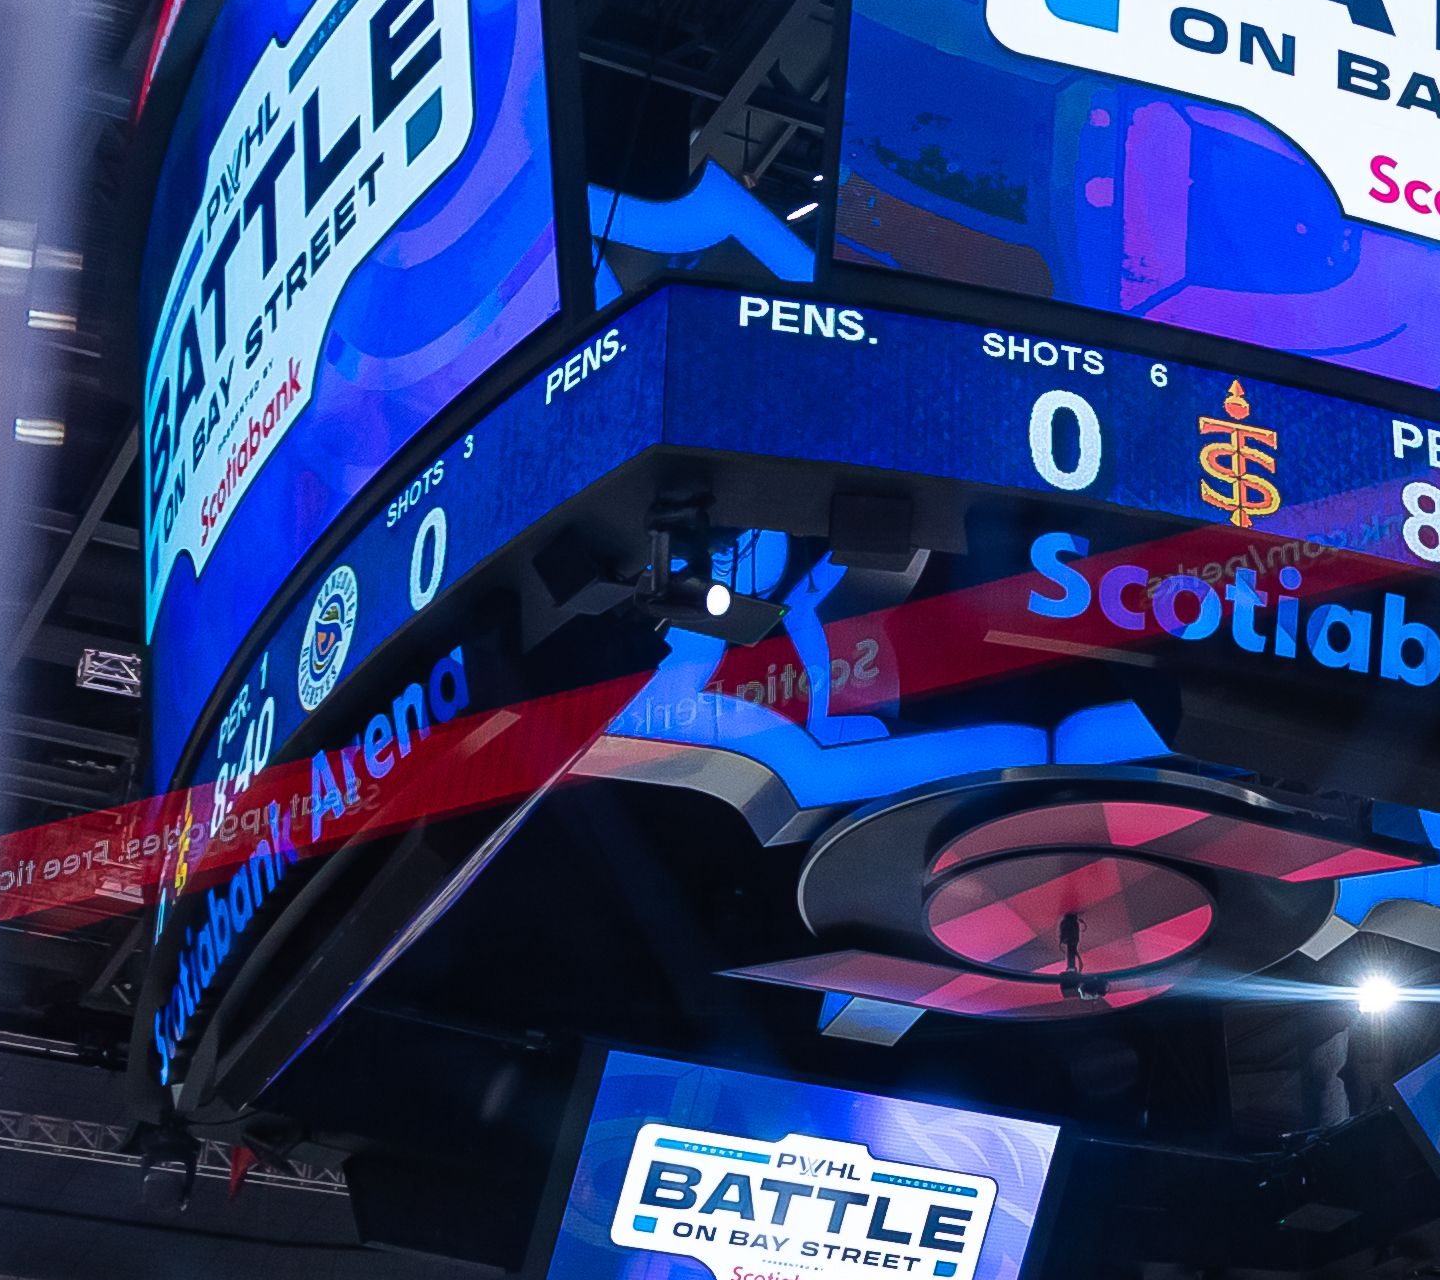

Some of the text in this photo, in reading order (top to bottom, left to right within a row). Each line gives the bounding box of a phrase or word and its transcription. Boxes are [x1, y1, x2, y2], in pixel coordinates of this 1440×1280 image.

[1169, 6, 1296, 76] ON
[206, 92, 281, 242] PWHL
[165, 153, 385, 544] ON BAY STREET
[545, 328, 628, 406] PENS.
[739, 296, 1169, 388] PENS. SHOTS 6
[200, 356, 302, 548] Scotiabank
[386, 434, 474, 528] SHOTS 3
[1029, 389, 1102, 491] 0
[410, 506, 447, 612] 0
[216, 651, 270, 758] PER. 1
[210, 696, 277, 839] 8:40
[154, 645, 471, 1082] Scotiabank Arena
[639, 1160, 974, 1254] BATTLE
[776, 1151, 862, 1182] PWHL
[672, 1222, 923, 1273] ON BAY STREET
